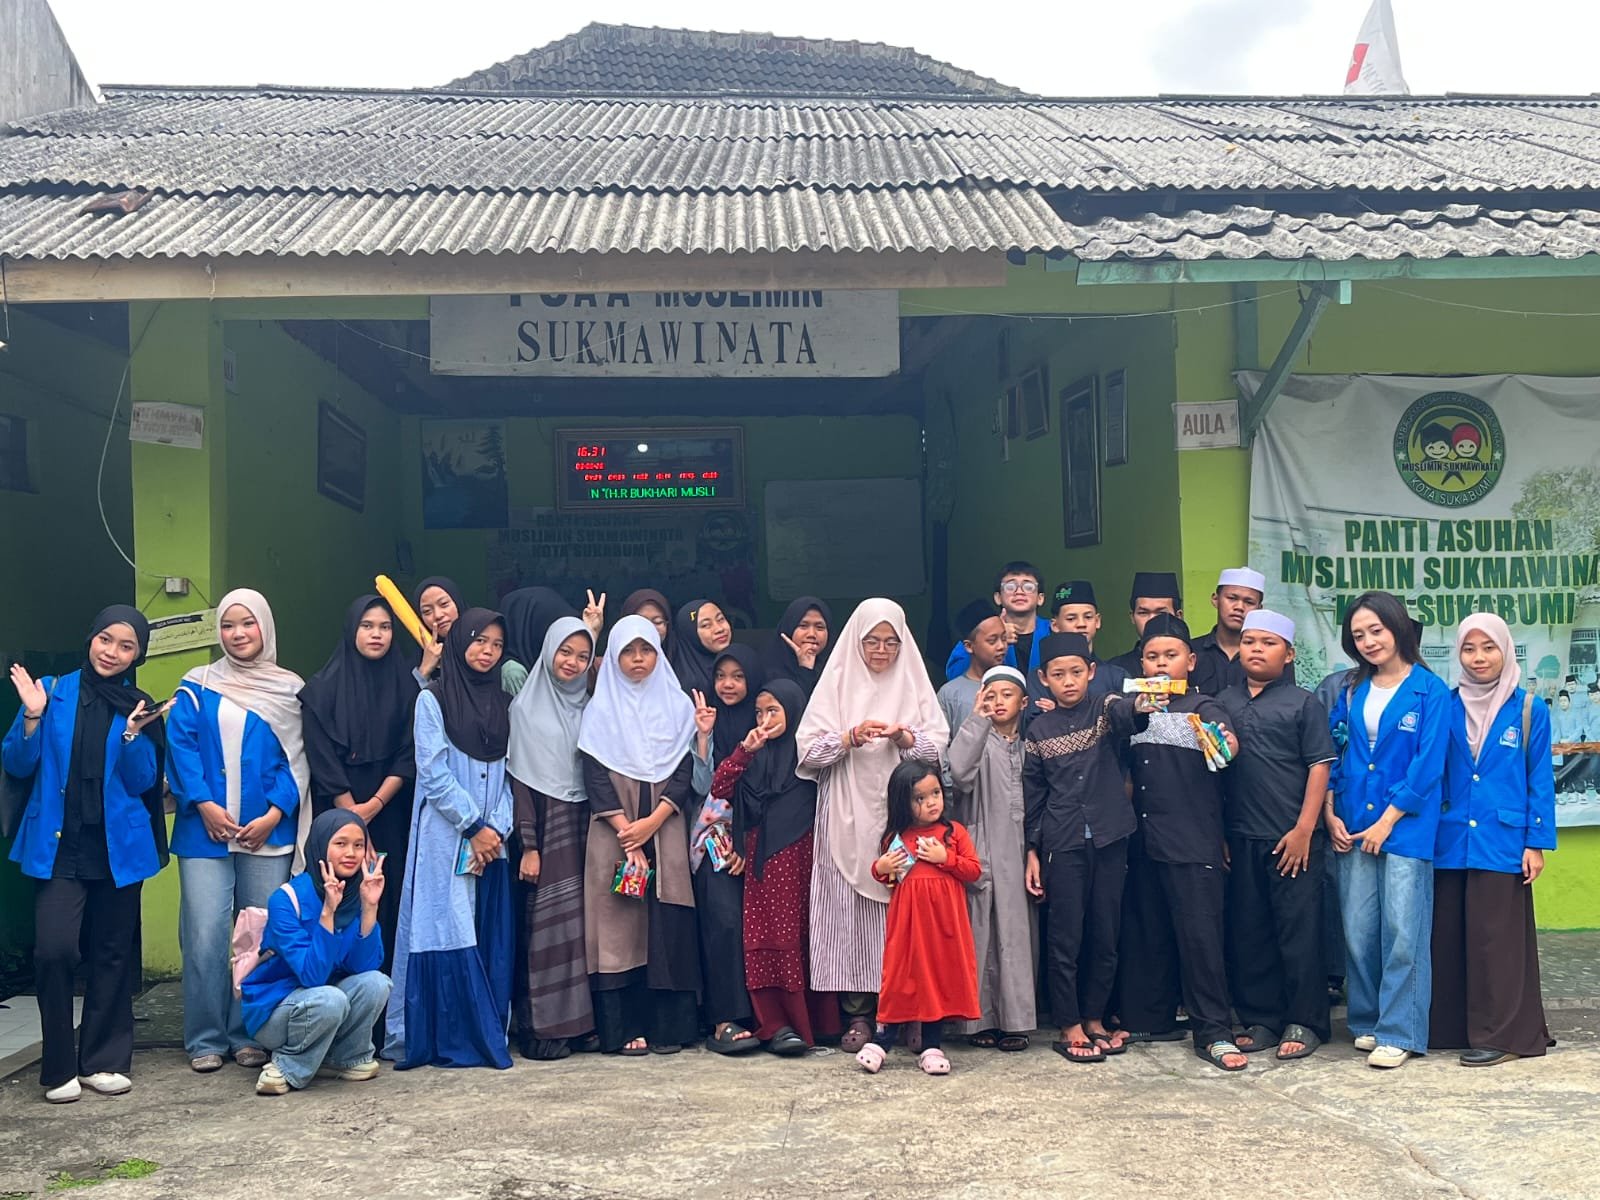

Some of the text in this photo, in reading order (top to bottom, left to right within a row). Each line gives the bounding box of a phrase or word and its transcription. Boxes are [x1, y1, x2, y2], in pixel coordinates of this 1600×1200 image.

[517, 320, 817, 365] SUKMAWINATA
[1183, 413, 1226, 436] AULA
[1402, 462, 1499, 472] MUSLIMIN SUKMAWINATA
[1411, 477, 1493, 506] KOTA SUKABUMI
[1345, 519, 1554, 552] PANTI ASUHAN
[1281, 550, 1414, 590] MUSLIMIN
[1417, 592, 1575, 627] SUKABUMI
